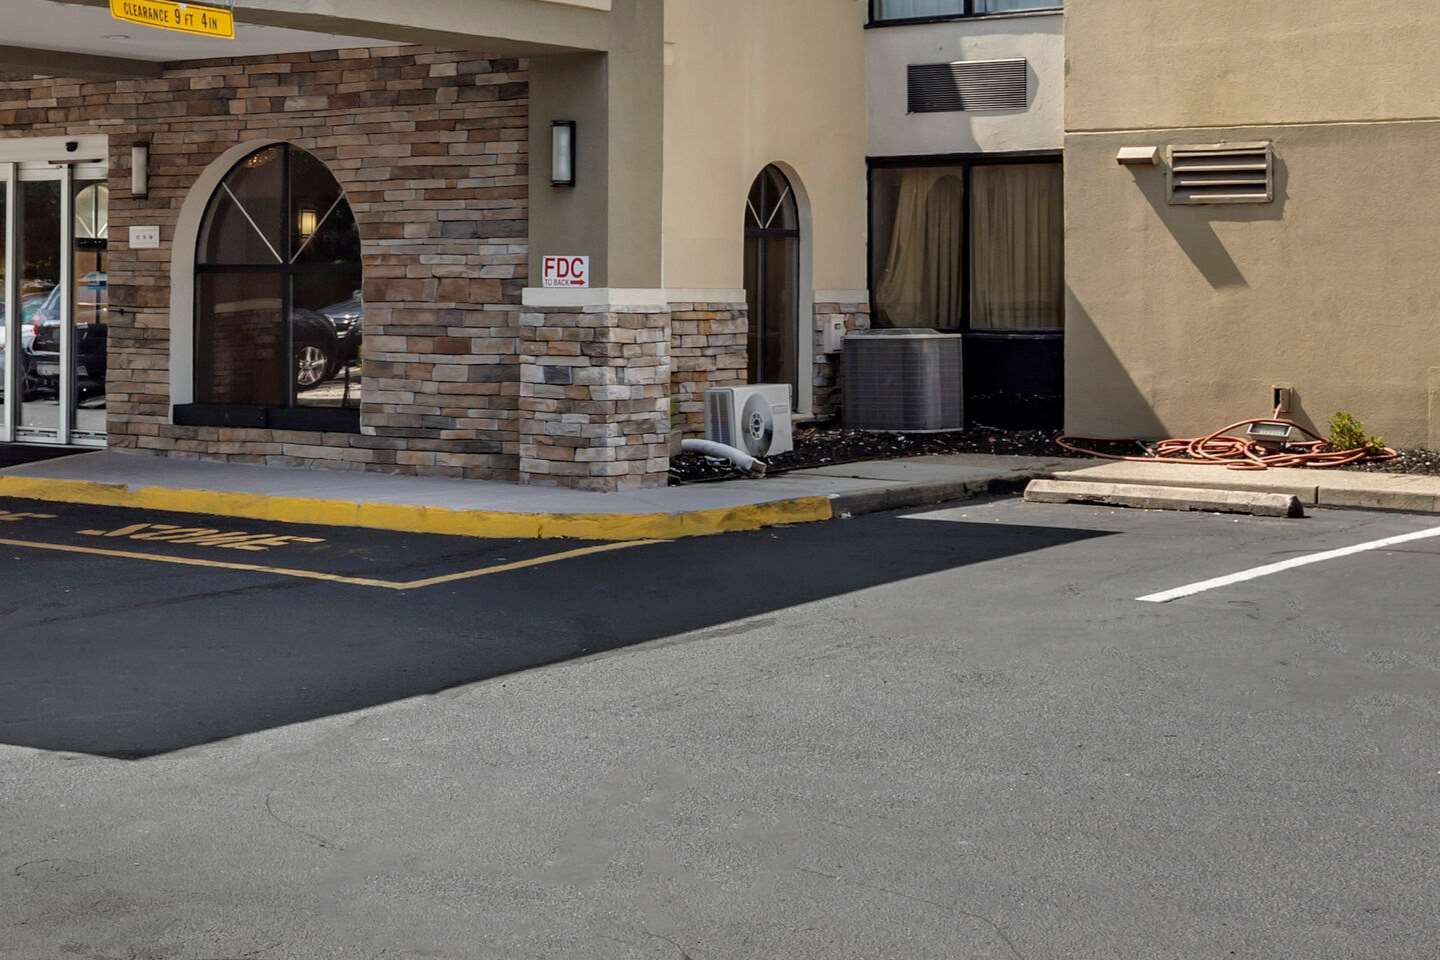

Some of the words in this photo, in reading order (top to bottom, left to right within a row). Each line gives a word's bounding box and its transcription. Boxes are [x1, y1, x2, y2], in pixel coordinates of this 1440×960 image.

[123, 1, 169, 23] CLEARANCE
[174, 8, 181, 25] 9
[184, 14, 194, 26] FT
[544, 257, 584, 278] FDC
[75, 523, 327, 551] ZONE
